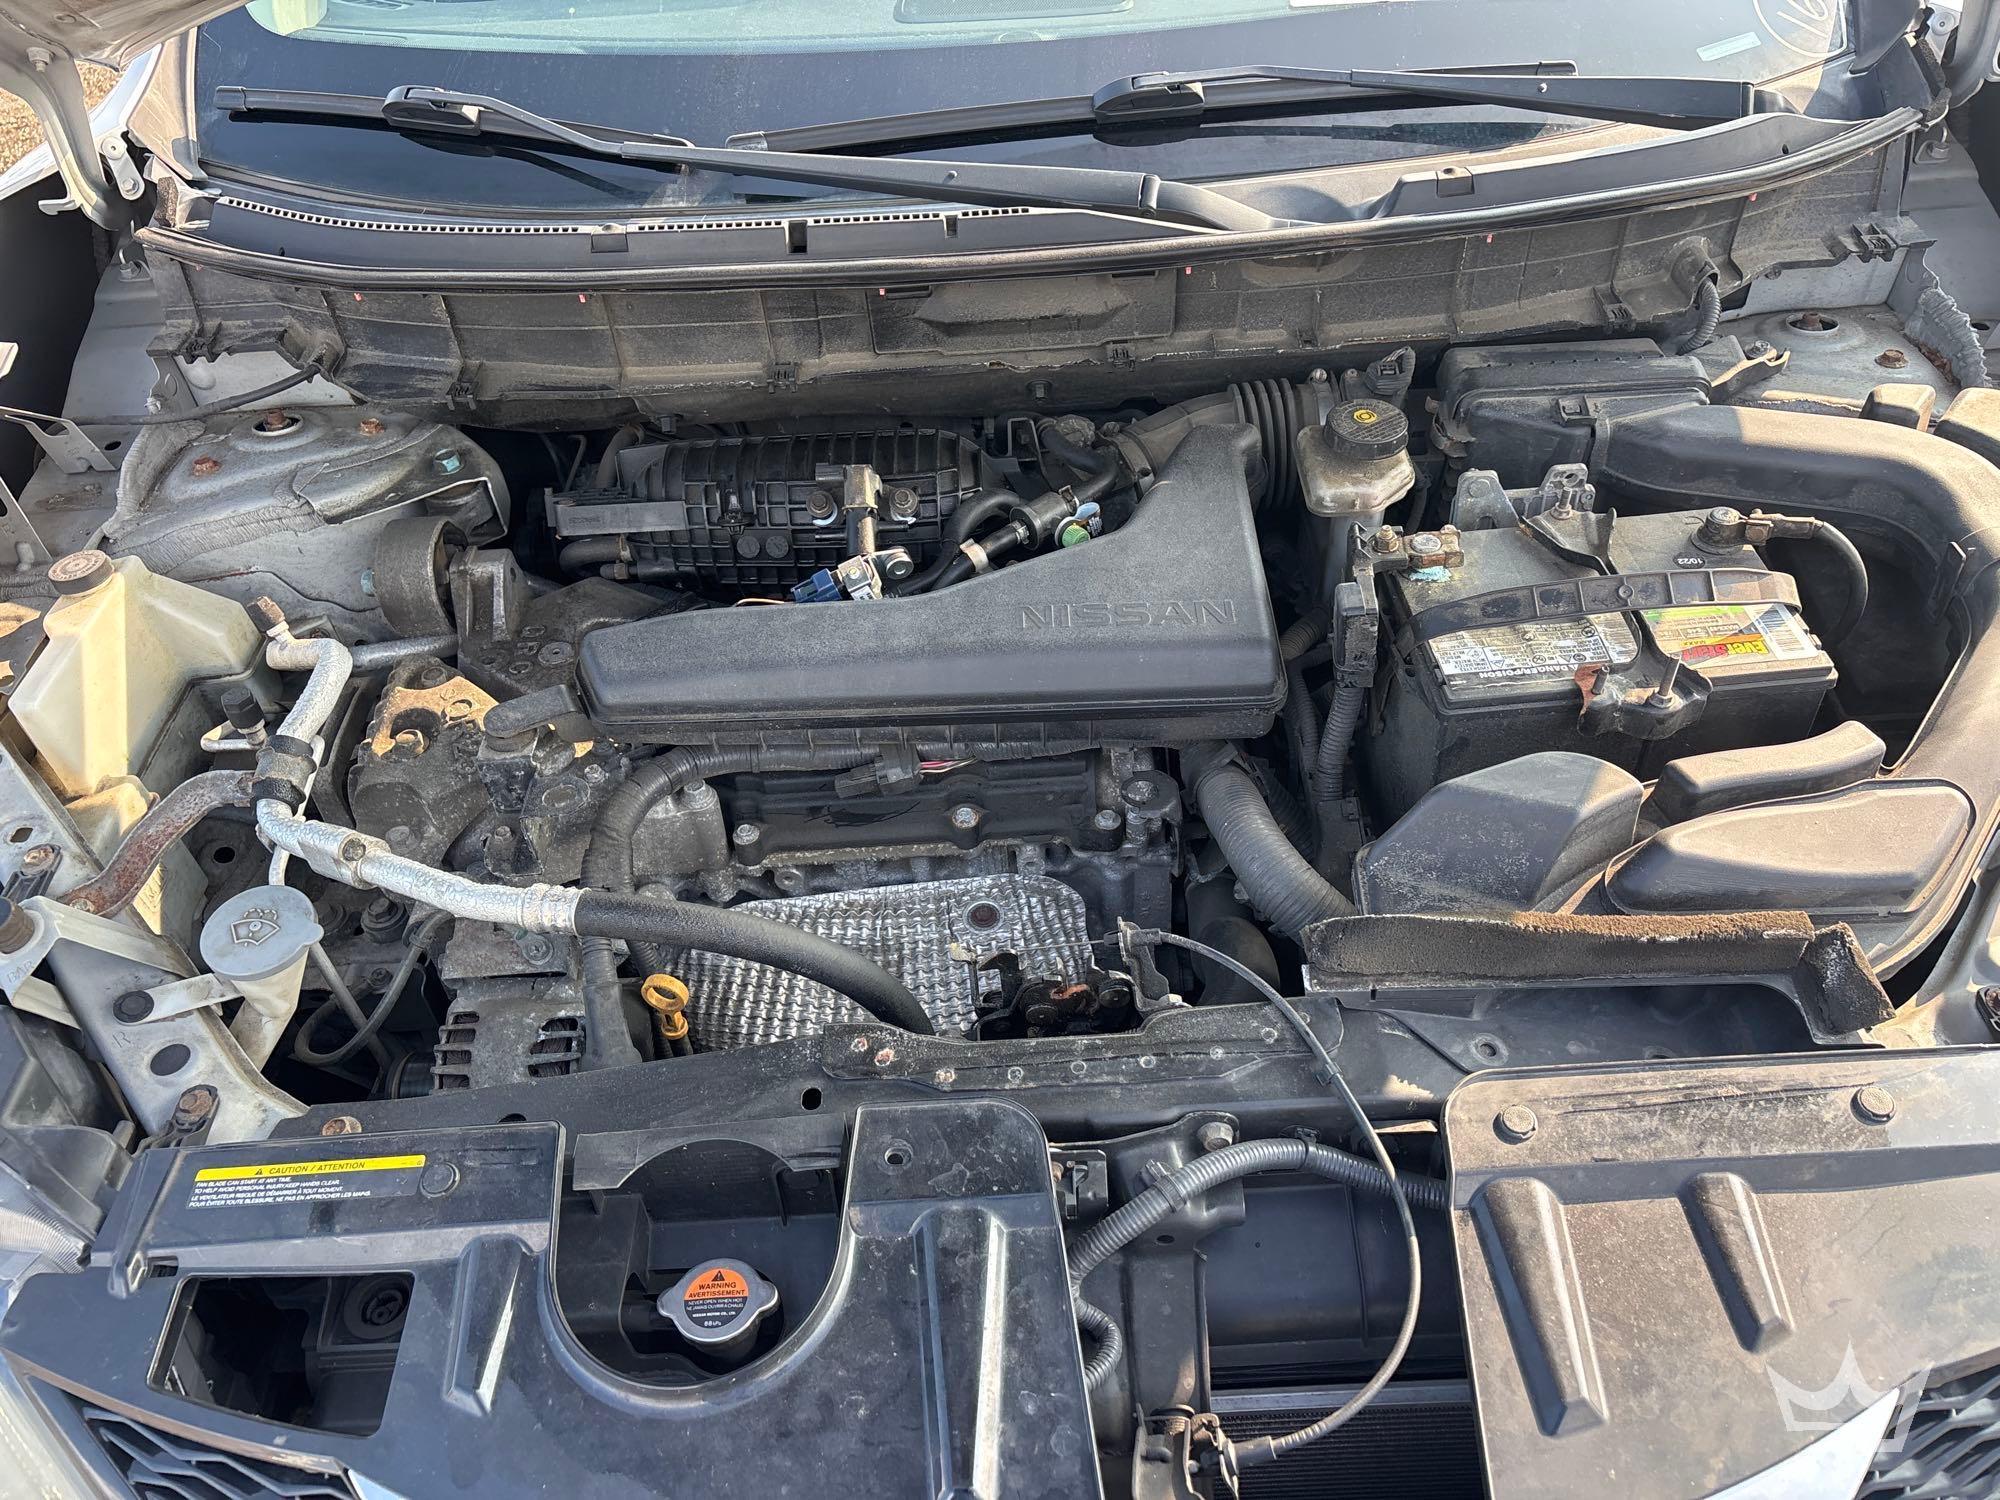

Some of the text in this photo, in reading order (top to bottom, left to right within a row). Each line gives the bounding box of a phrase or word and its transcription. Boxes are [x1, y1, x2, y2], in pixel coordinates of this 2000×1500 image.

[1677, 557, 1704, 565] 10/22
[1021, 599, 1237, 629] NISSAN
[1682, 640, 1769, 661] EverStart
[1479, 664, 1569, 678] DANGER/POISON
[269, 1166, 308, 1175] CAUTION
[317, 1162, 365, 1171] ATTENTION
[305, 1192, 340, 1200] APPROCHER
[698, 1282, 736, 1290] WARNING
[689, 1290, 745, 1298] AVERTISSEMENT
